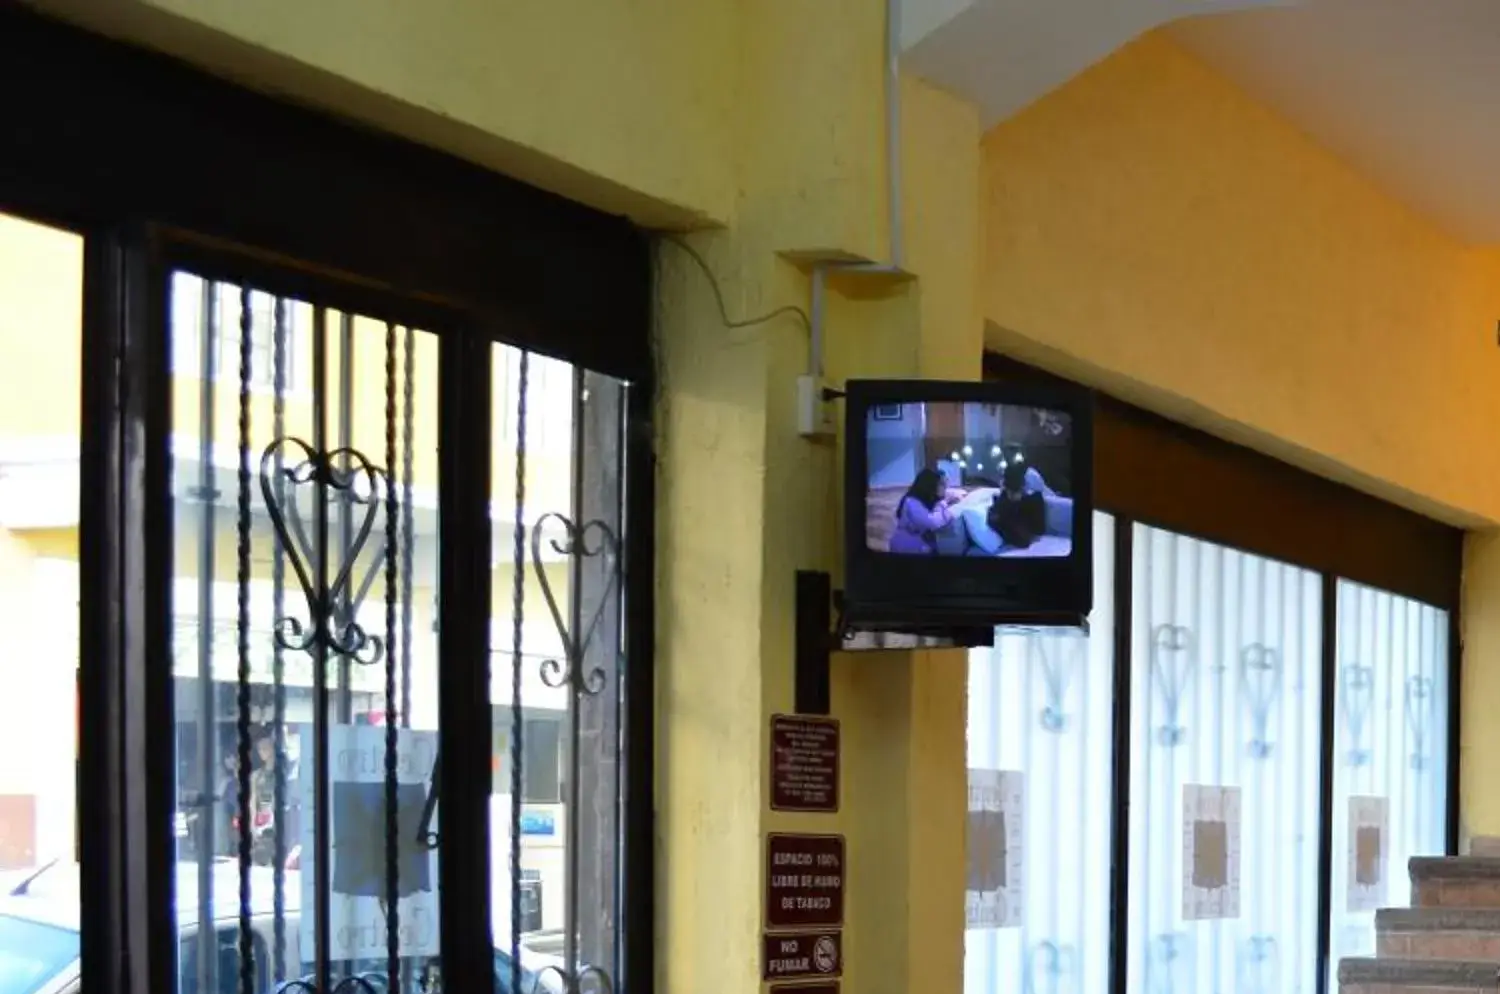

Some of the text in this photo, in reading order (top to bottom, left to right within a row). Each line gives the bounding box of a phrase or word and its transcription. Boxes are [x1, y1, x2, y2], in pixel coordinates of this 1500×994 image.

[774, 852, 813, 866] ESPACIO
[772, 875, 799, 889] LIBRE
[800, 874, 813, 889] DE
[782, 896, 832, 910] DE TABACO
[781, 939, 799, 954] NO
[768, 956, 810, 973] FUMAR
